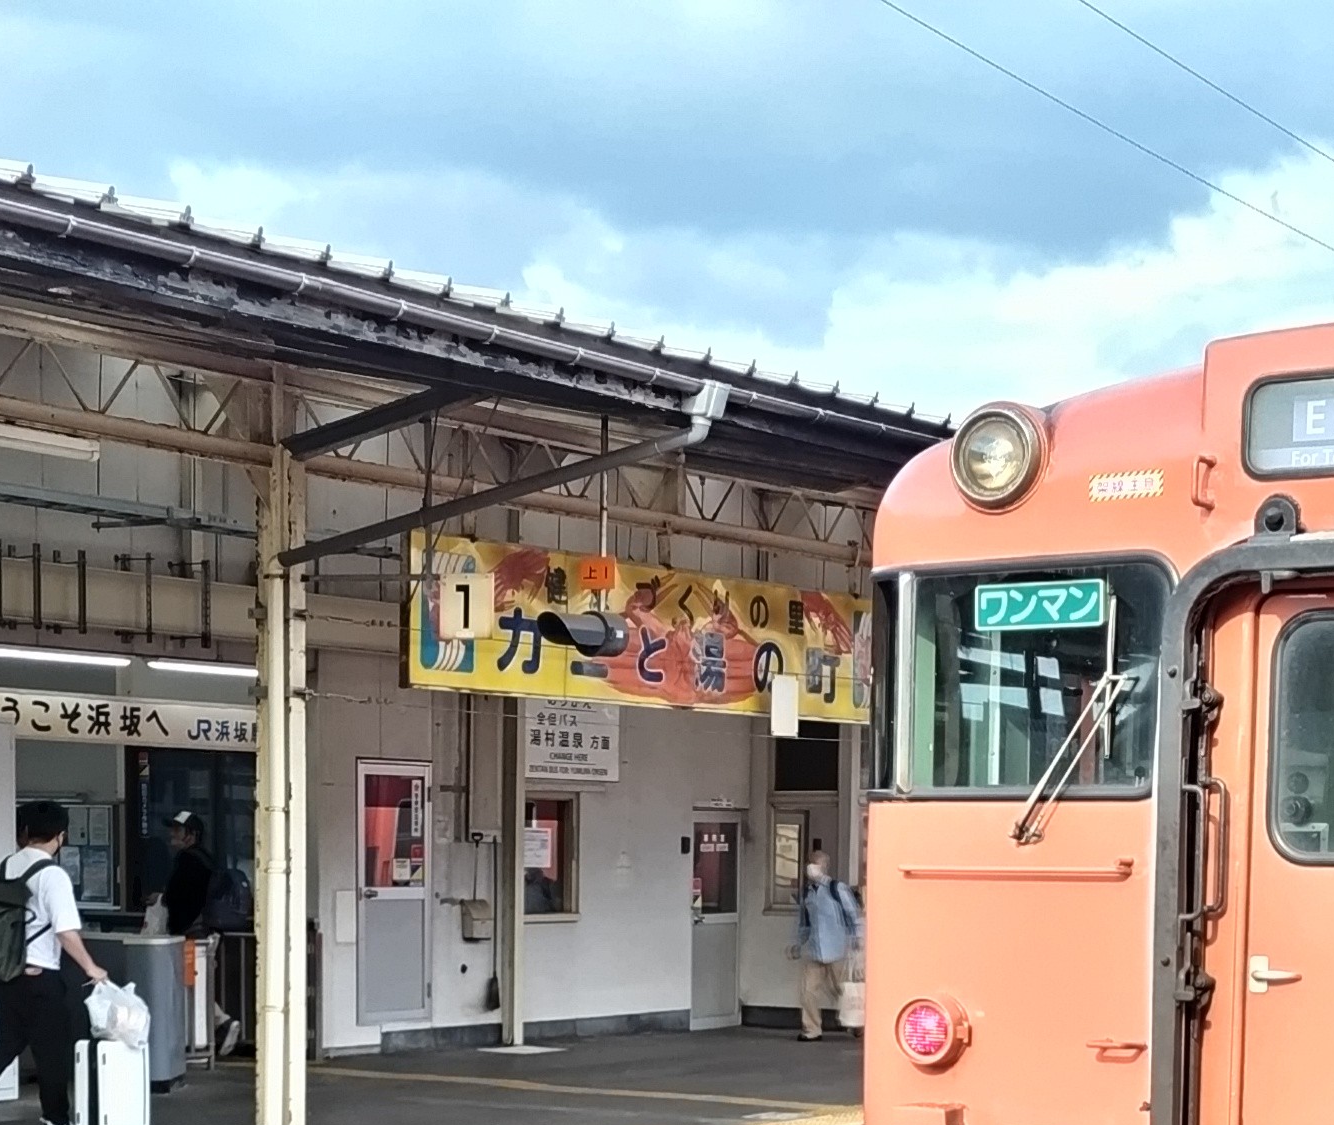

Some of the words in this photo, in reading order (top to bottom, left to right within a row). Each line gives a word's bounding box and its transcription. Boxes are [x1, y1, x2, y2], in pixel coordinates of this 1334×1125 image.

[1306, 399, 1326, 435] E
[1291, 449, 1318, 467] For
[455, 584, 469, 630] 1
[545, 565, 804, 636] 健づくりの里
[981, 586, 1098, 625] ワンマン
[530, 729, 583, 748] 湯村温泉
[590, 735, 610, 750] 方面
